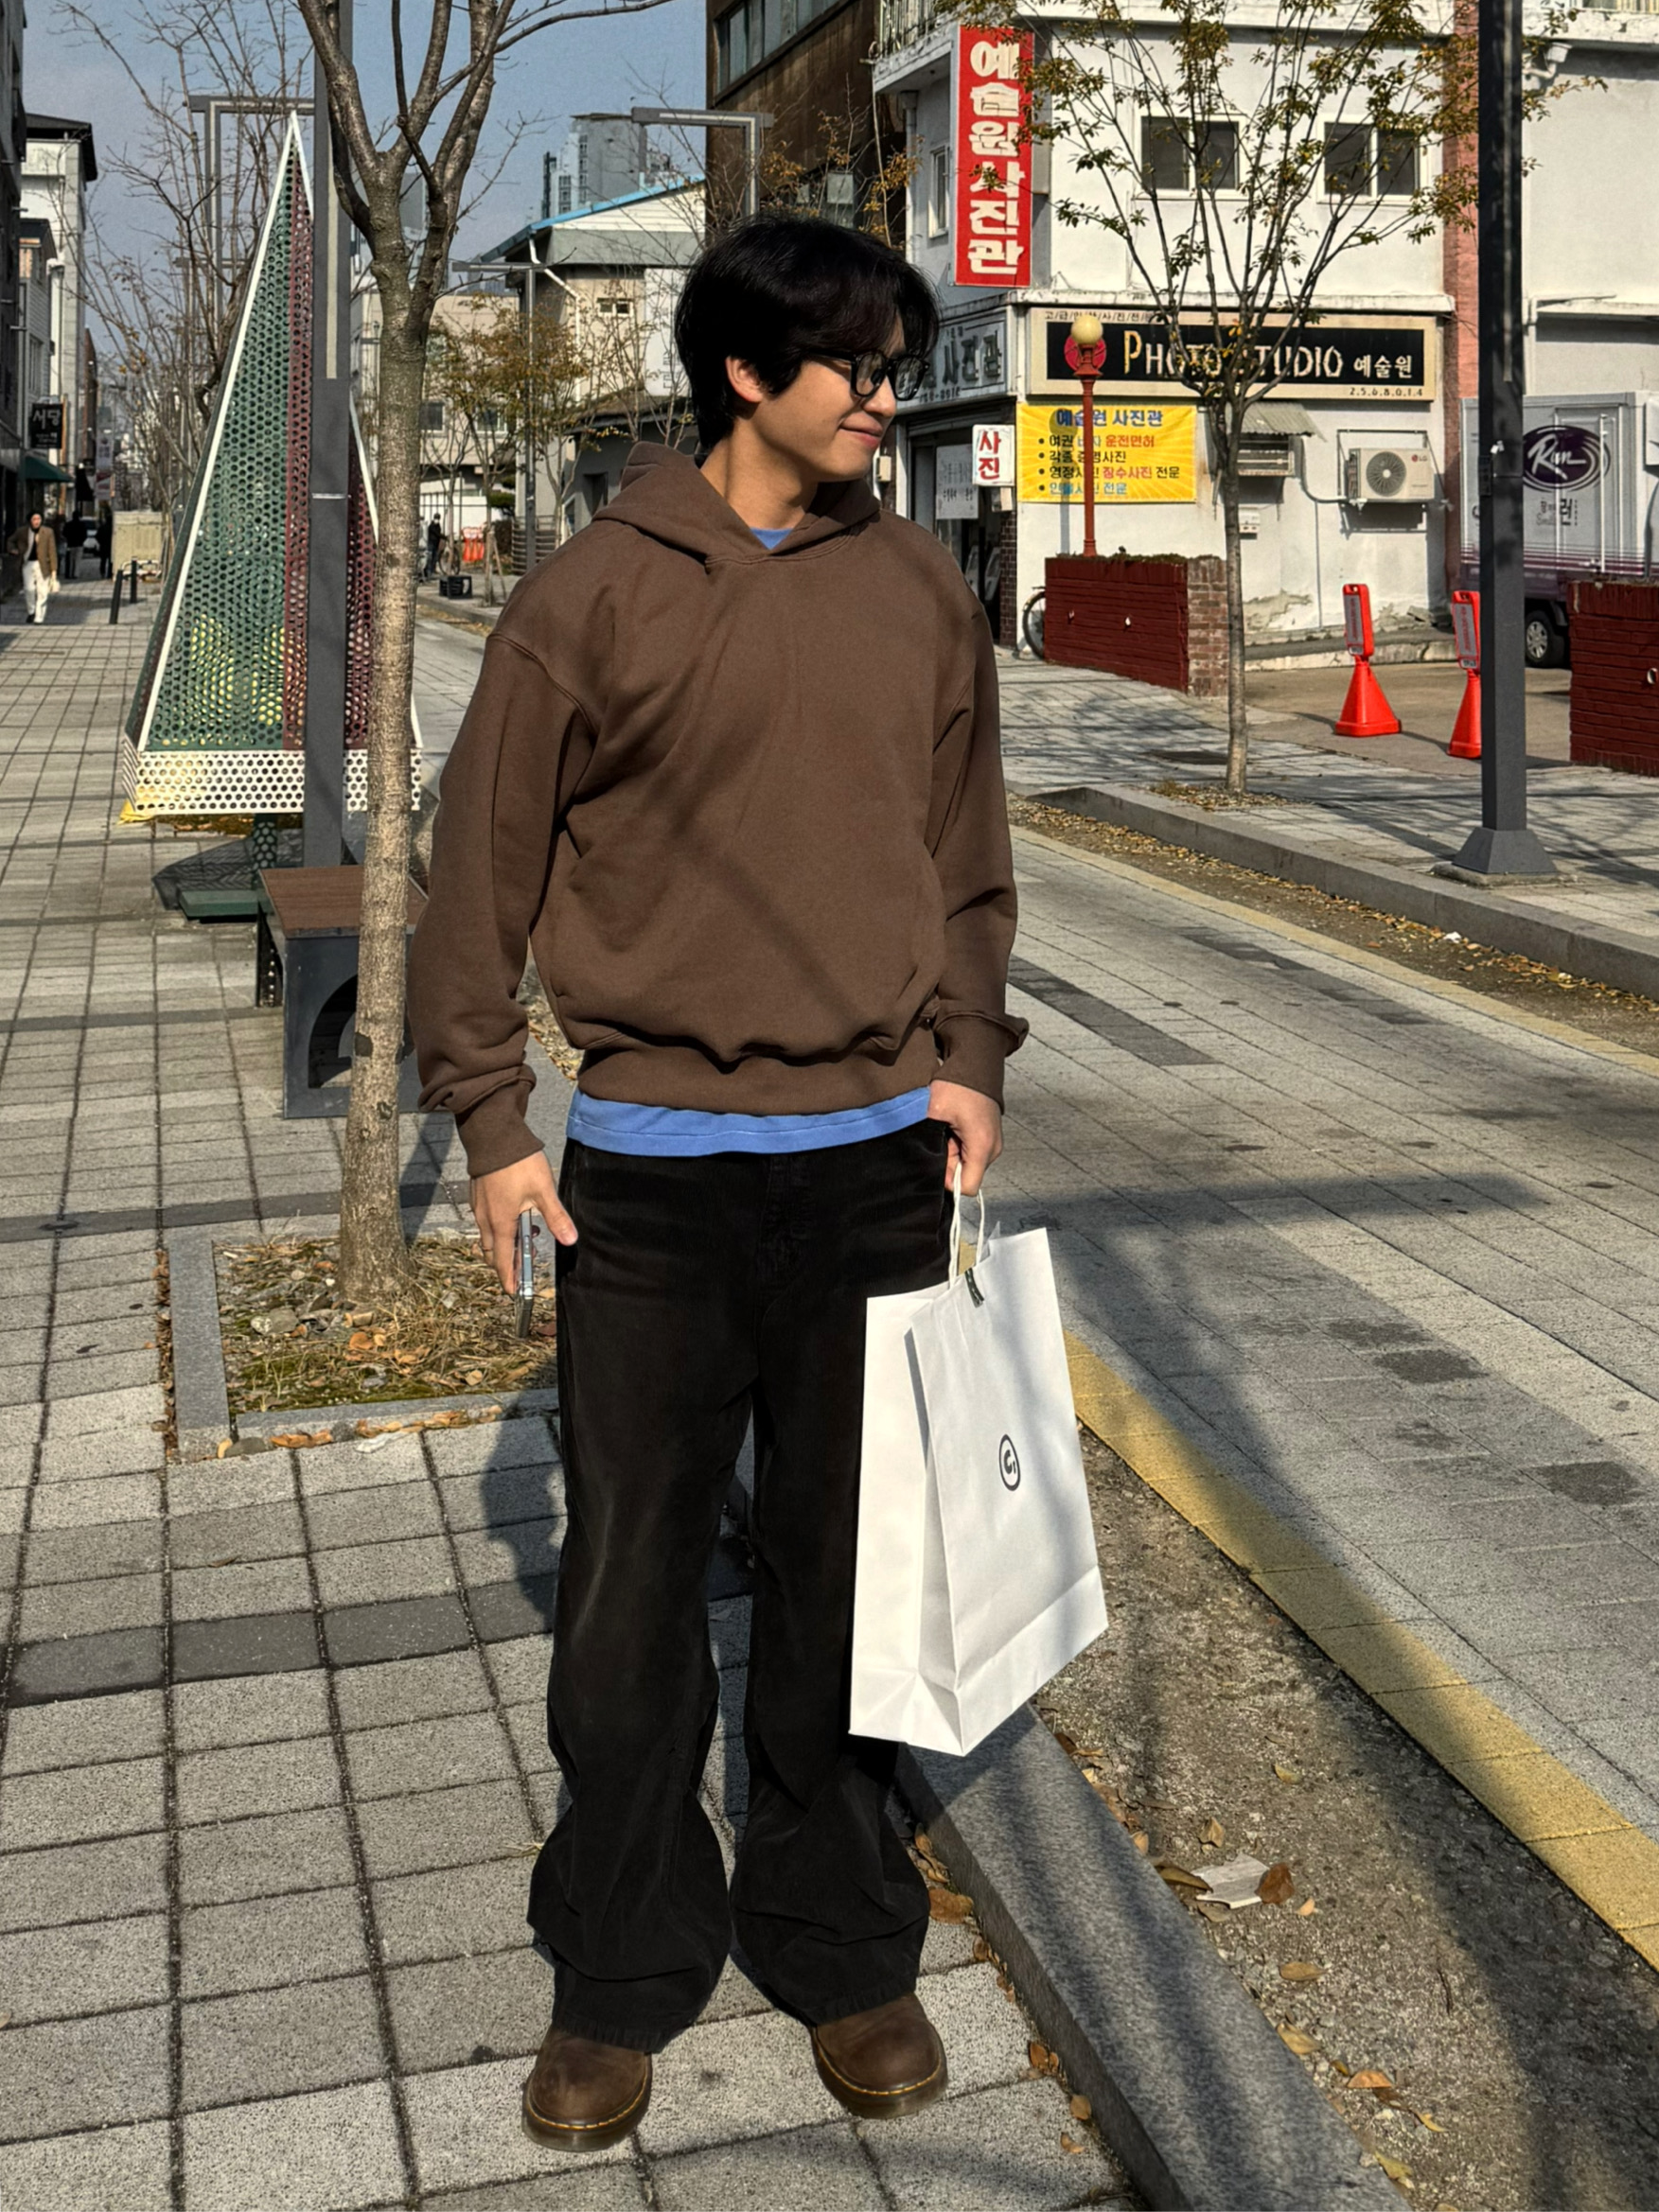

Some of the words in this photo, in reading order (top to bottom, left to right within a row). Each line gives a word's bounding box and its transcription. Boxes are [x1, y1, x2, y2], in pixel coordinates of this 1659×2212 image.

[1232, 344, 1343, 377] TUDIO
[1353, 354, 1413, 378] 예술원
[1112, 409, 1163, 427] 사진관
[1050, 434, 1073, 447] 여권
[1105, 434, 1155, 448] 운전면허
[979, 430, 1001, 480] 사진
[1050, 450, 1073, 463] 각종
[1103, 466, 1152, 480] 장수사진
[1156, 466, 1179, 479] 전문
